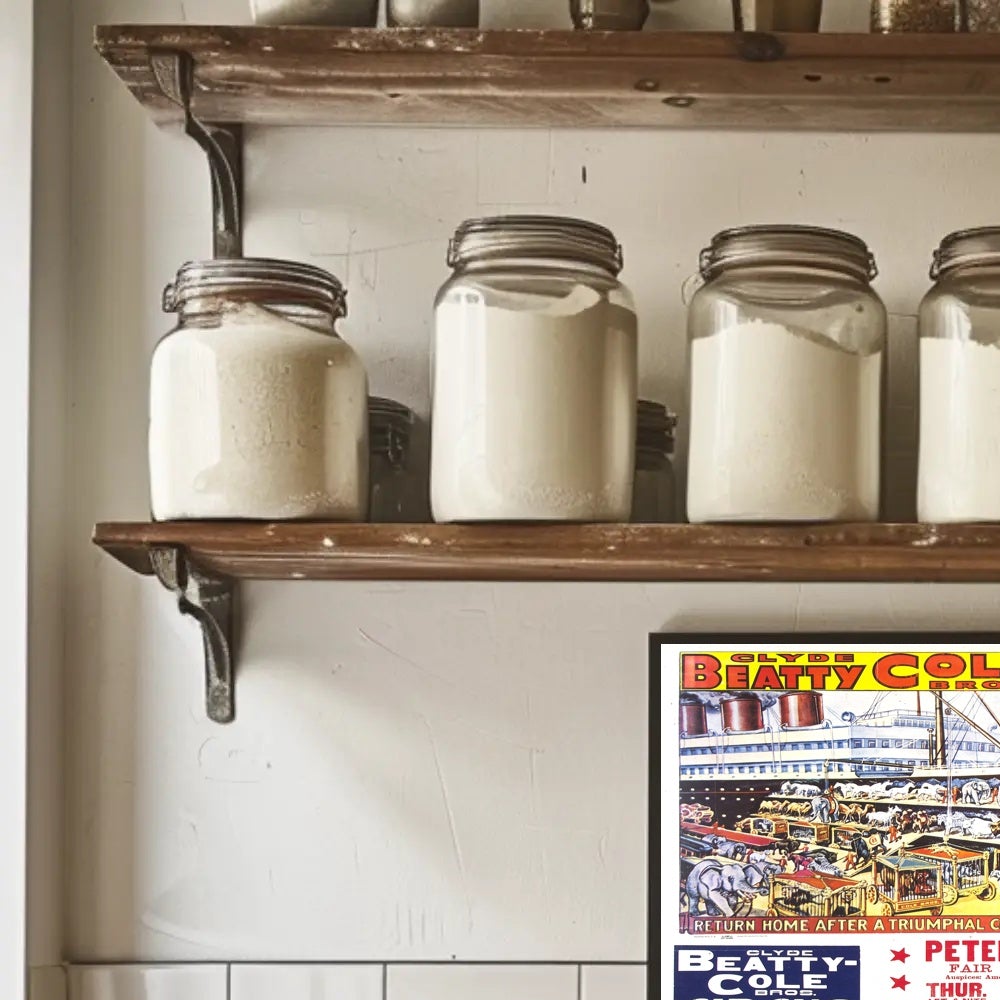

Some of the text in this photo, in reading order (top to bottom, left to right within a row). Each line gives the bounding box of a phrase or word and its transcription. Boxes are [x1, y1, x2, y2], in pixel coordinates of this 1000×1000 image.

[730, 653, 855, 662] CLYDE
[682, 653, 866, 690] BEATTY
[694, 918, 755, 932] RETURN
[762, 918, 808, 932] HOME
[815, 918, 867, 932] AFTER
[873, 918, 885, 931] A
[888, 918, 984, 931] TRIUMPHAL
[678, 949, 857, 972] BEATTY-
[949, 964, 992, 973] FAIR
[707, 974, 828, 996] COLE
[926, 982, 987, 997] THUR.
